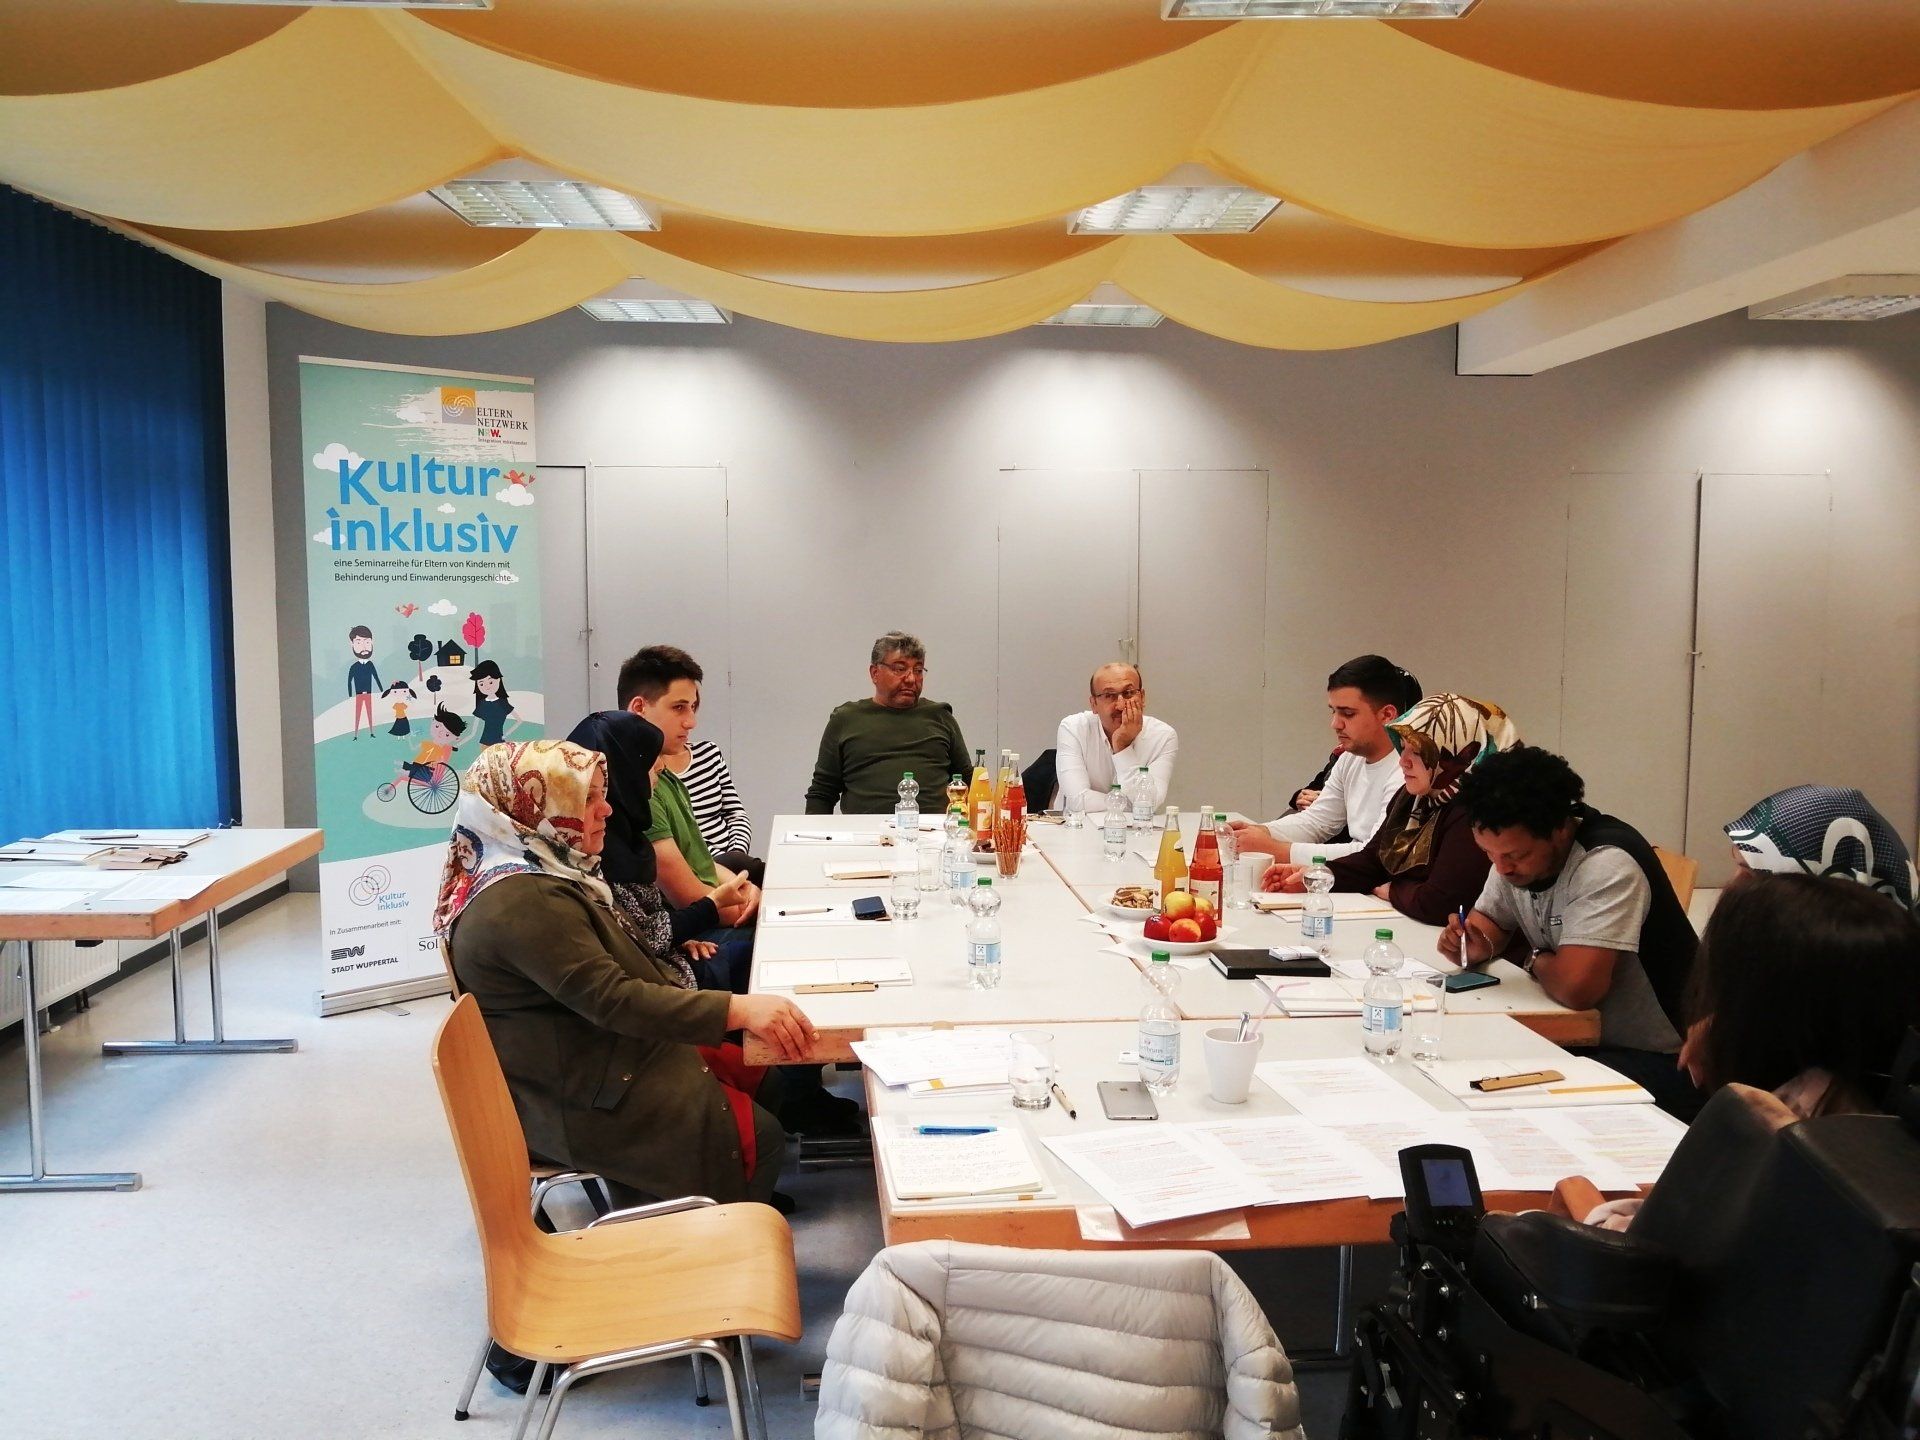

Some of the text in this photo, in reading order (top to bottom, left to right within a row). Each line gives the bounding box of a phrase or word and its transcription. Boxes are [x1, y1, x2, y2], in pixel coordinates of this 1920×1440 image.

[477, 407, 513, 418] ELTERN
[477, 418, 529, 430] NETZWERK
[339, 453, 500, 506] Kultur
[326, 506, 519, 554] inklusiv
[333, 558, 353, 567] eine
[354, 558, 410, 567] Seminarreihe
[411, 558, 423, 568] für
[424, 559, 448, 568] Eltern
[465, 560, 496, 568] Kindern
[497, 560, 511, 569] mit
[334, 572, 390, 583] Behinderung
[391, 573, 408, 581] und
[378, 891, 407, 903] Kultur
[337, 920, 389, 935] Zusammenarbeit
[331, 957, 399, 975] STADT WUPPERTAL
